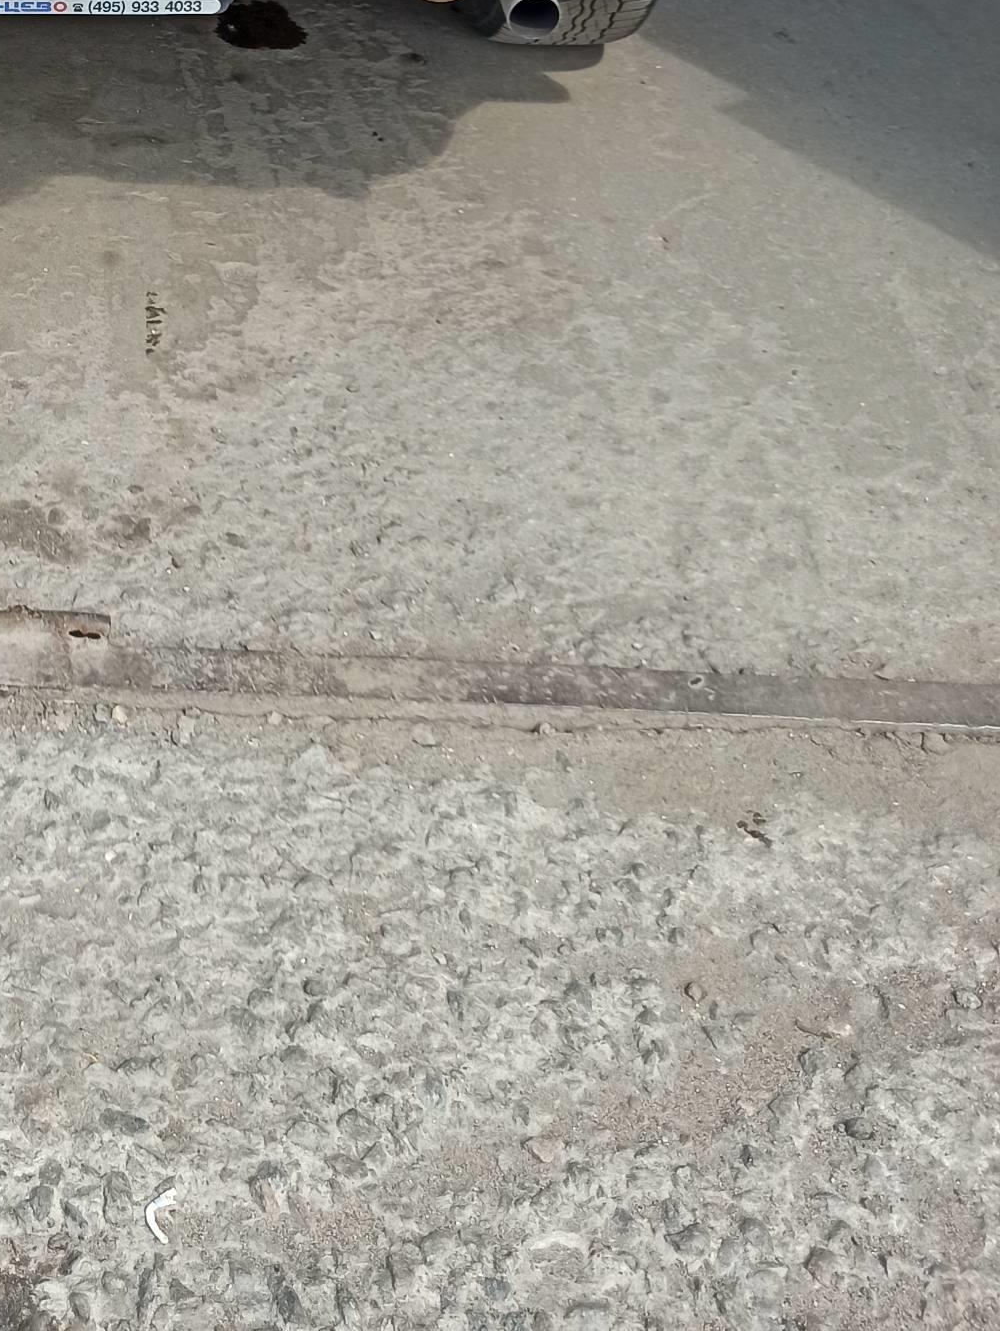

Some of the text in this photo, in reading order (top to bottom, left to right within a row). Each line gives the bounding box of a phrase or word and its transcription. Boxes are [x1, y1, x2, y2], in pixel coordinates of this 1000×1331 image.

[88, 0, 126, 15] (495)
[131, 1, 160, 13] 933
[165, 1, 202, 13] 4033
